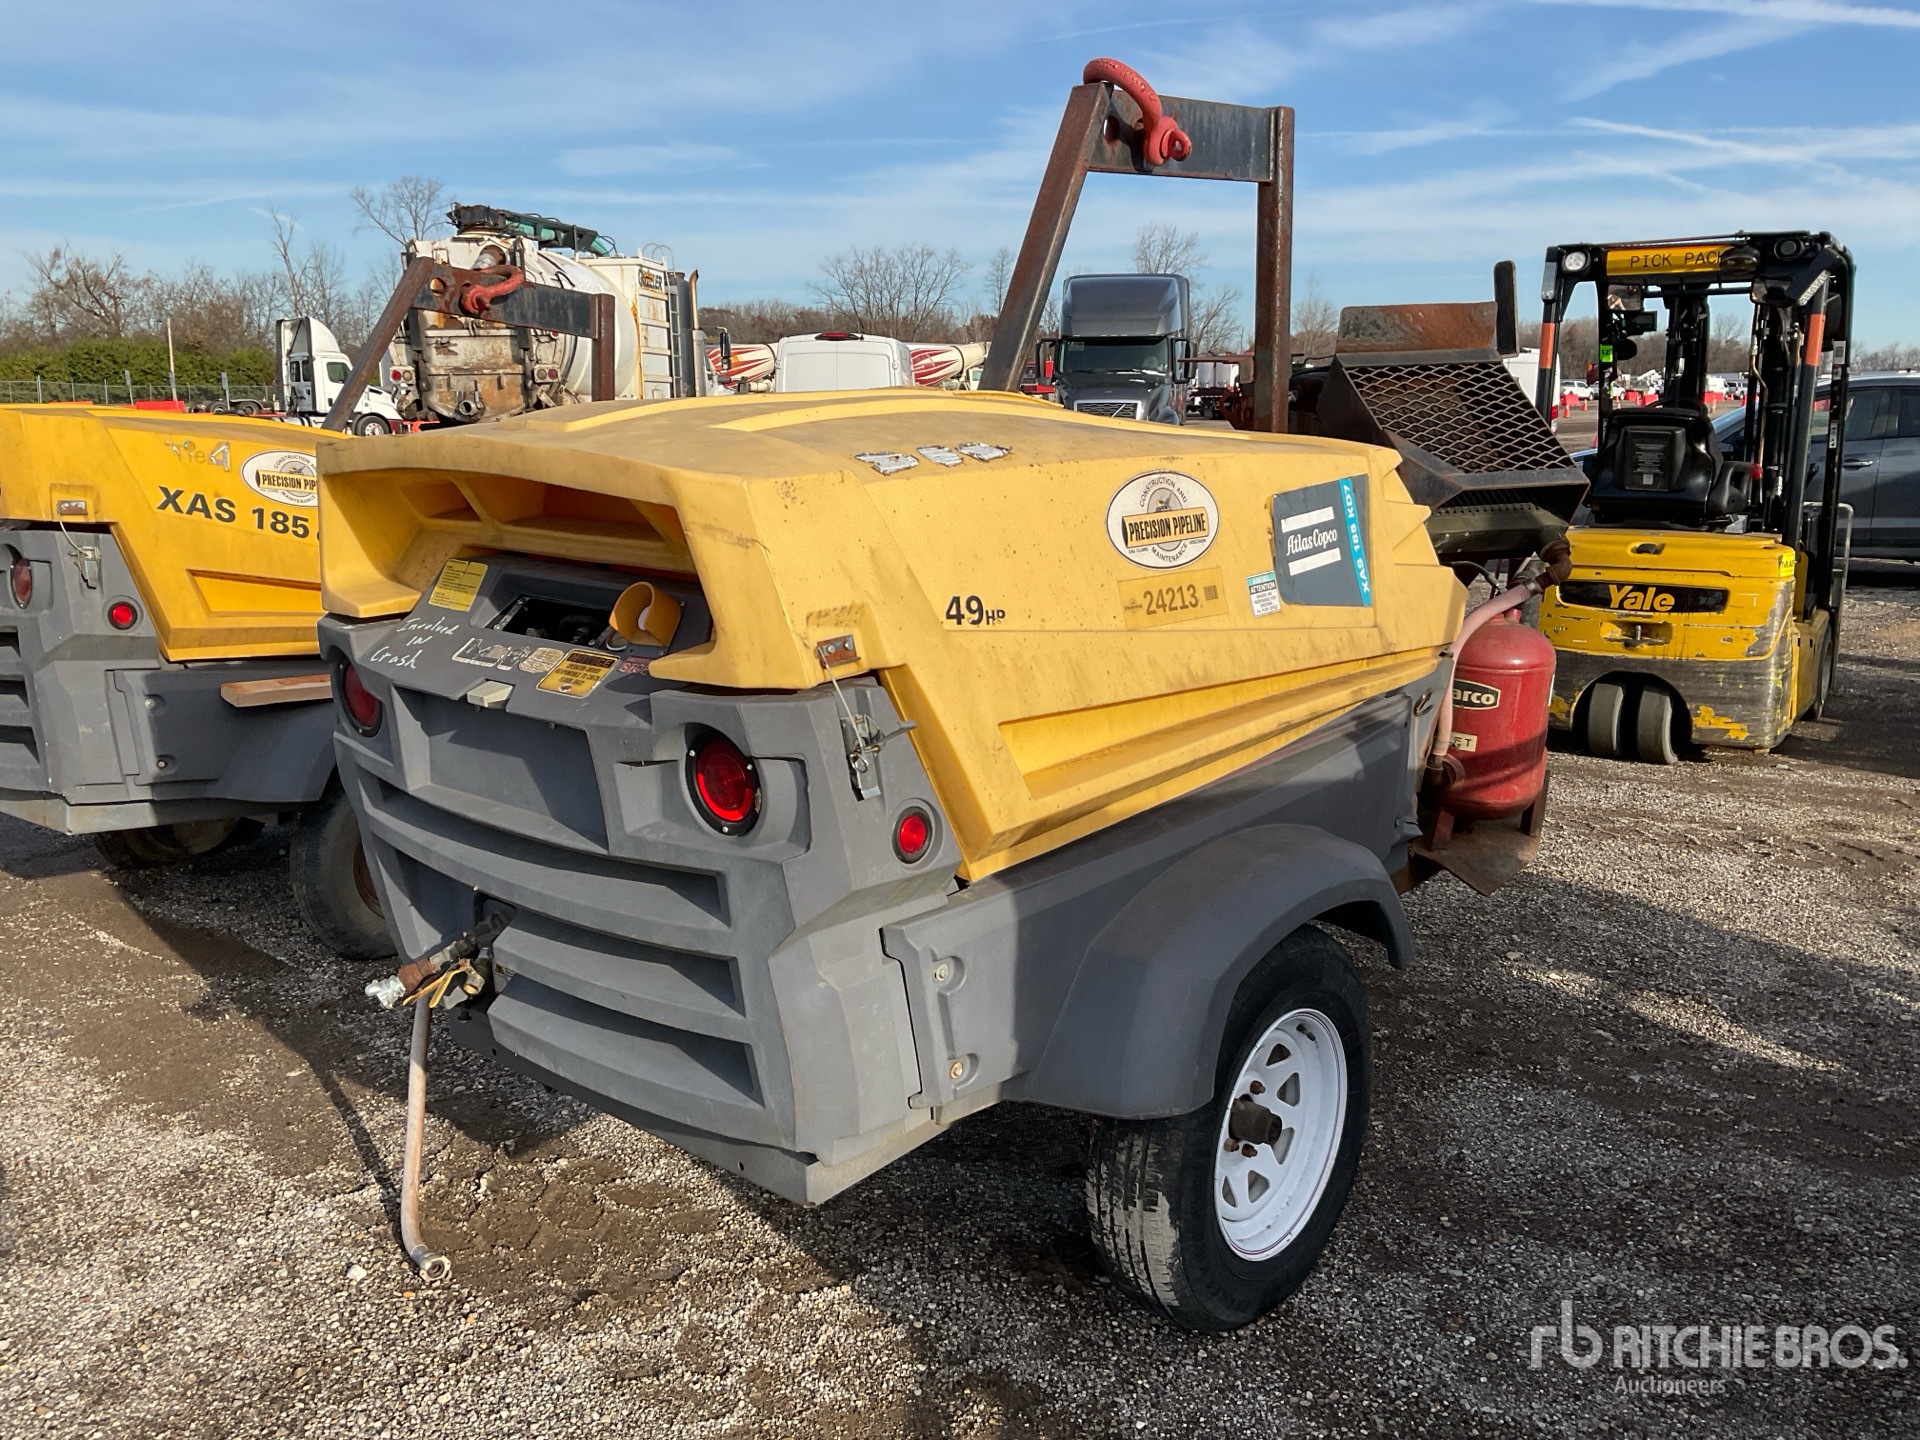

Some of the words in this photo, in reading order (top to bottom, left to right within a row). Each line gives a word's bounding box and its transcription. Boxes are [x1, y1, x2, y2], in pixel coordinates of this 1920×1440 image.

[1629, 253, 1672, 268] PICK
[274, 454, 311, 469] CONSTRUCTION
[261, 473, 302, 490] PRECISION
[1139, 476, 1176, 507] CONSTRUCTION
[1176, 487, 1188, 503] AND
[281, 491, 316, 504] MAINTENANCE
[1343, 484, 1355, 519] KD7
[157, 485, 236, 523] XAS
[252, 507, 310, 539] 185
[1128, 518, 1172, 542] PRECISION
[1171, 513, 1207, 536] PIPELINE
[1150, 541, 1188, 563] MAINTENANCE
[1286, 533, 1313, 556] Atlas
[1312, 528, 1338, 549] Copco
[1356, 557, 1370, 593] XAS
[1143, 583, 1199, 616] 24213
[1608, 584, 1675, 612] Yale
[396, 616, 459, 635] Involved
[406, 635, 433, 647] IN
[369, 646, 423, 669] Crash
[568, 654, 614, 668] NOTICE
[1453, 688, 1495, 705] arco
